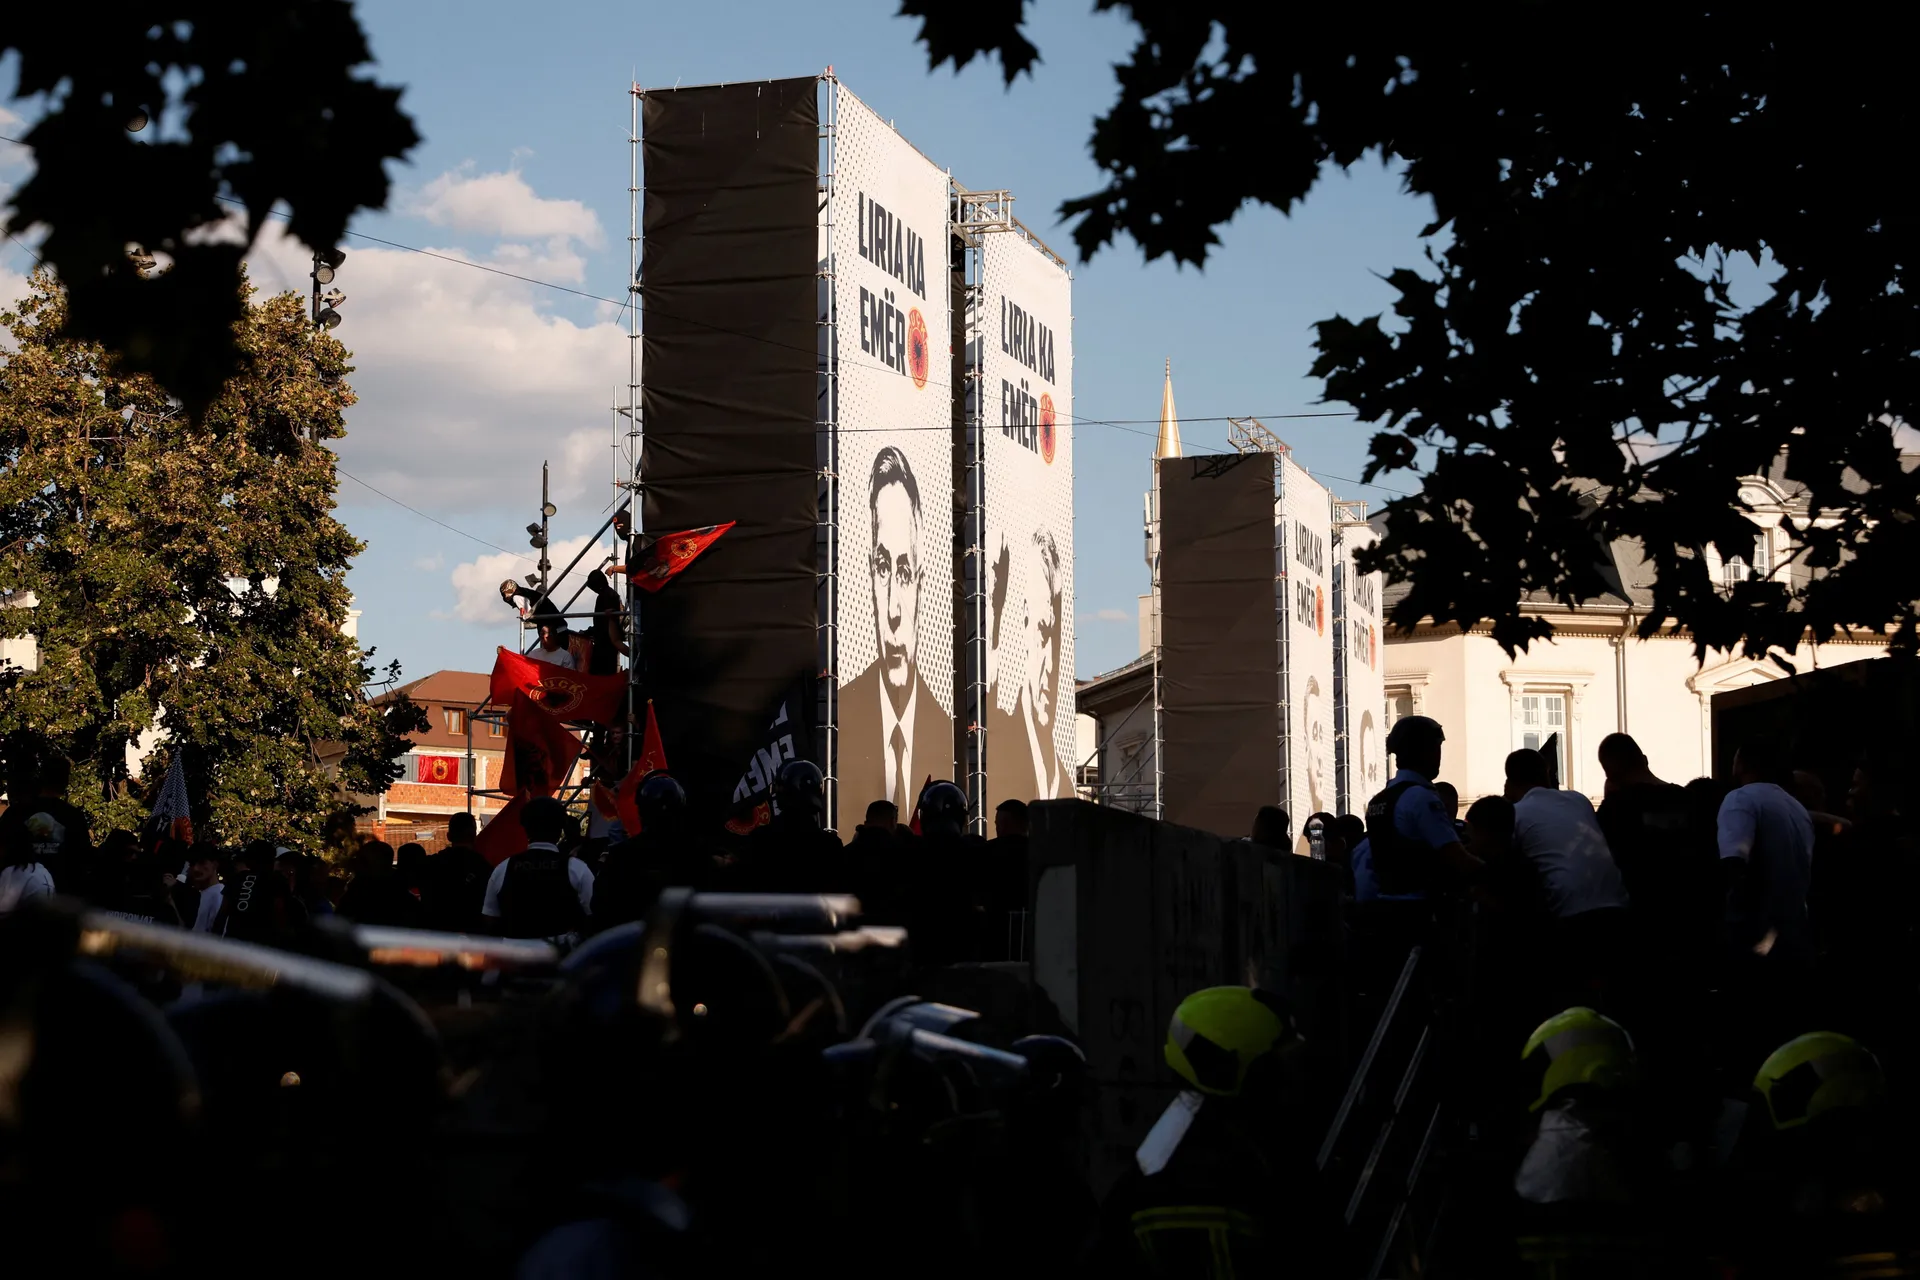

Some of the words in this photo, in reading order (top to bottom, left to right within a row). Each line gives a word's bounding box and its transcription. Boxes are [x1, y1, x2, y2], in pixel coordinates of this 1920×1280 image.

[858, 190, 904, 285] LIRIA
[907, 226, 926, 301] KA
[860, 285, 906, 376] EMËR
[1001, 294, 1037, 373] LIRIA
[1039, 322, 1056, 386] KA
[1001, 377, 1038, 454] EMËR
[1295, 519, 1314, 572] LIRIA
[1314, 533, 1324, 578] KA
[1296, 577, 1316, 631] EMËR
